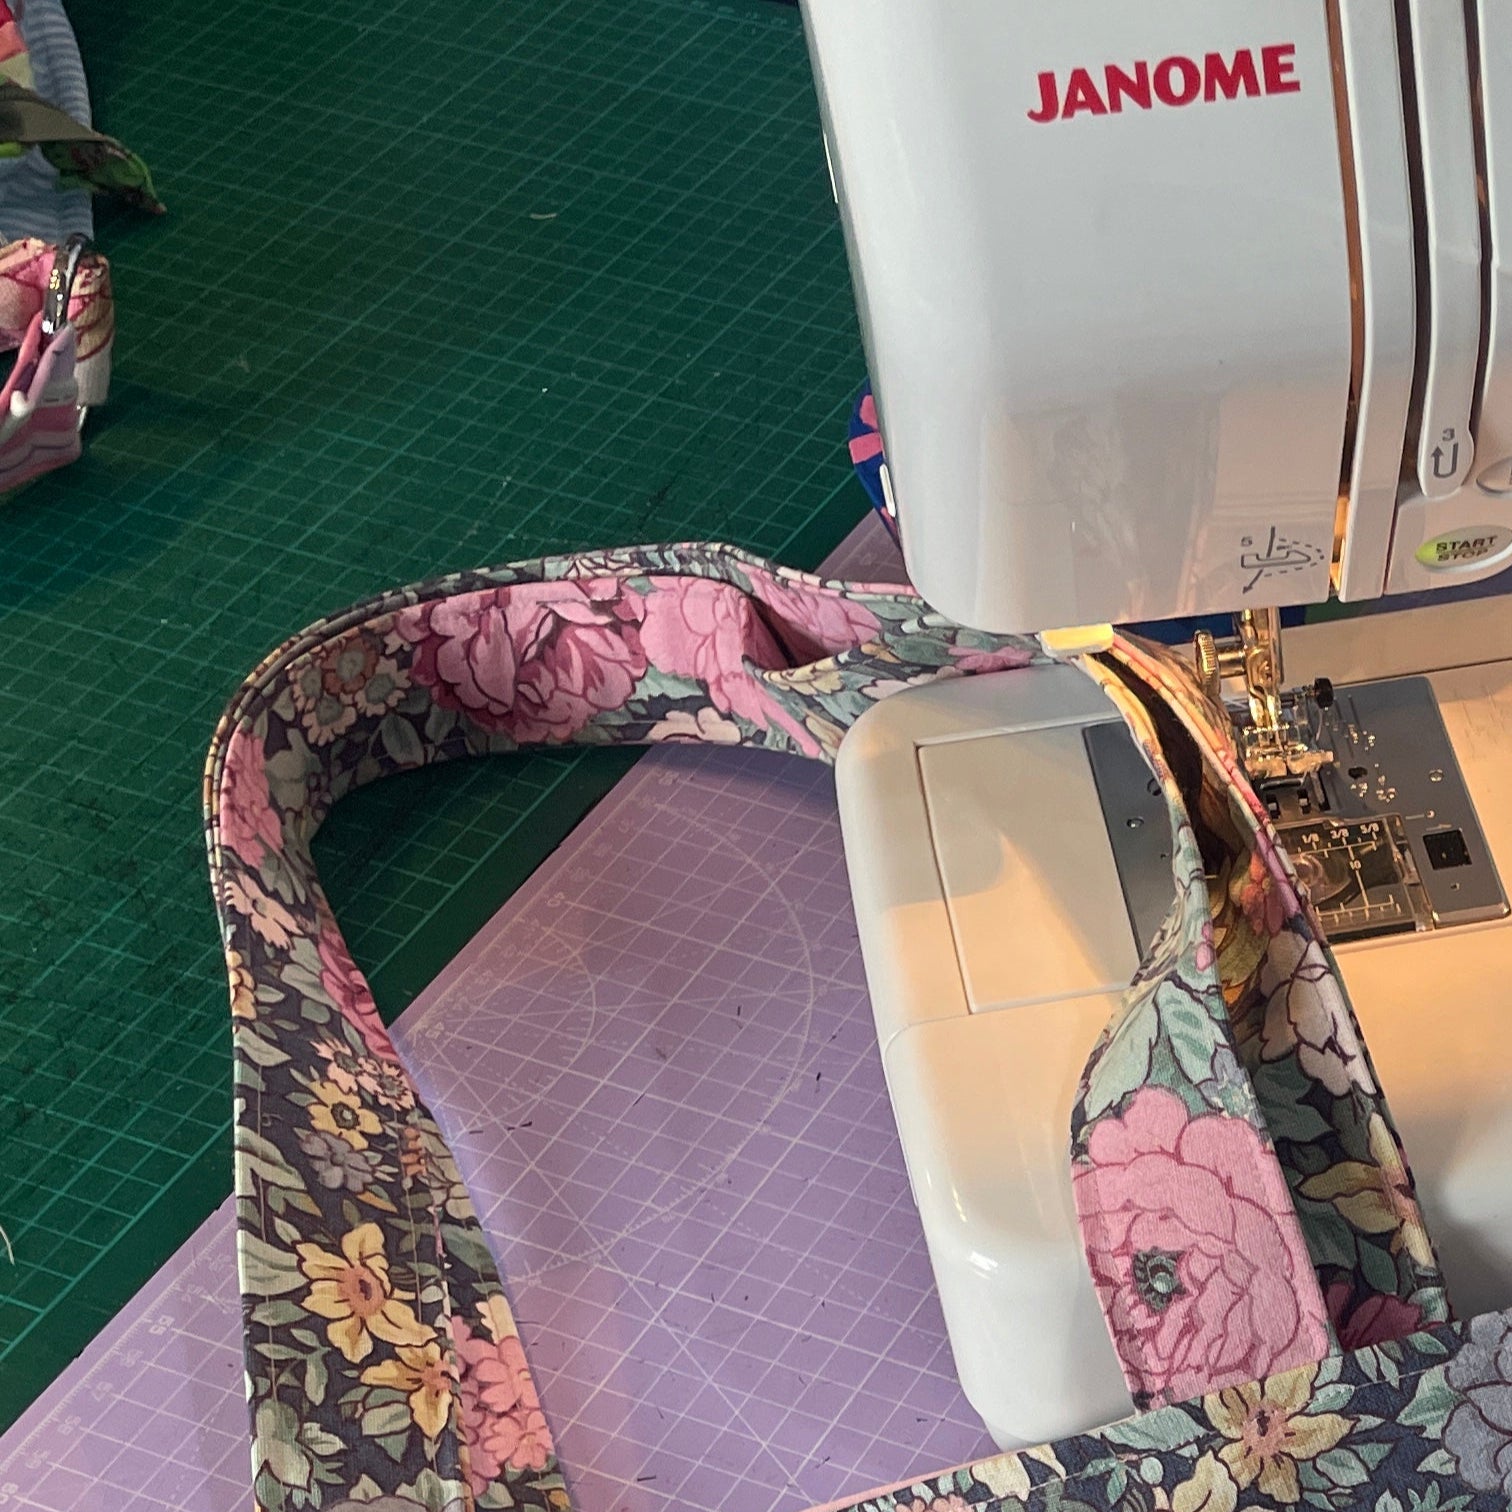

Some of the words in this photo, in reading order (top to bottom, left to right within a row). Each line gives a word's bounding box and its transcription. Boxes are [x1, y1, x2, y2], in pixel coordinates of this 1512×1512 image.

[1026, 43, 1301, 123] JANOME
[1442, 428, 1455, 441] 3
[1436, 535, 1498, 551] START
[1437, 546, 1489, 561] STOP
